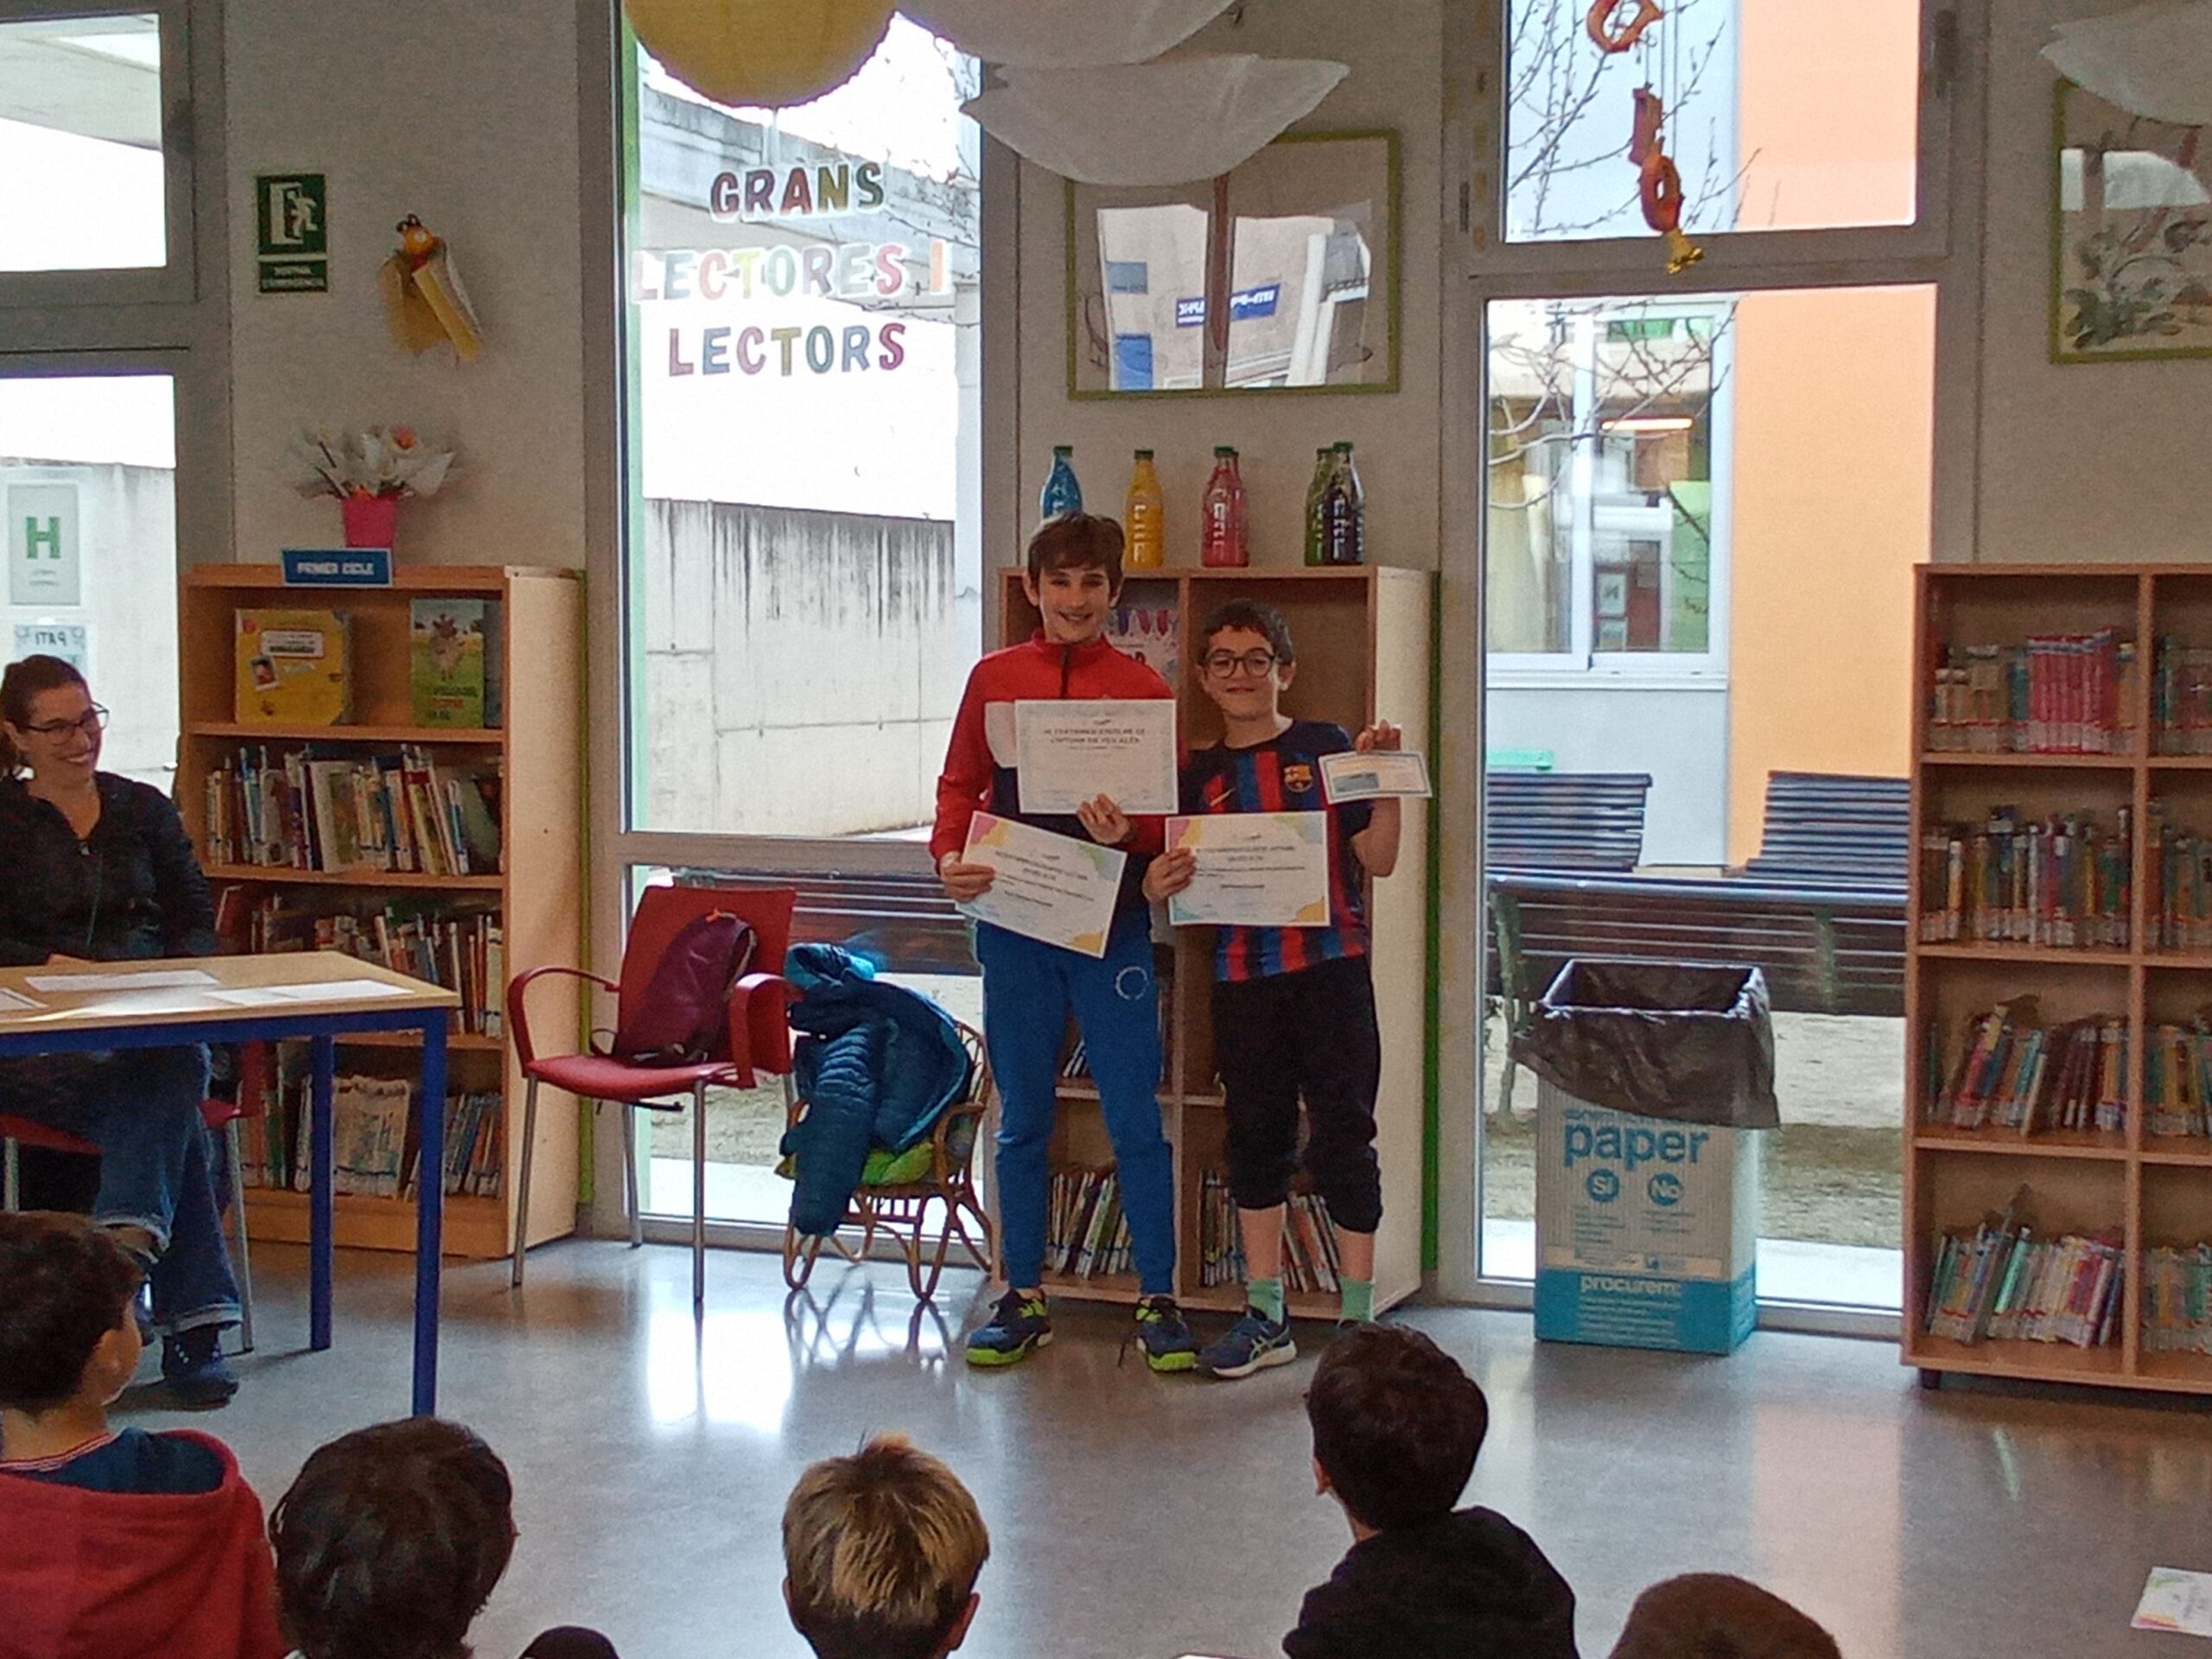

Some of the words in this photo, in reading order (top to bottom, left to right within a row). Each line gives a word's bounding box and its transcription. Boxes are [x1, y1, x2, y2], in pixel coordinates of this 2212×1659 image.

[710, 162, 884, 217] GRANS
[632, 243, 904, 301] LECTORES
[669, 322, 906, 377] LECTORS
[26, 516, 61, 559] H
[1563, 1124, 1710, 1171] paper
